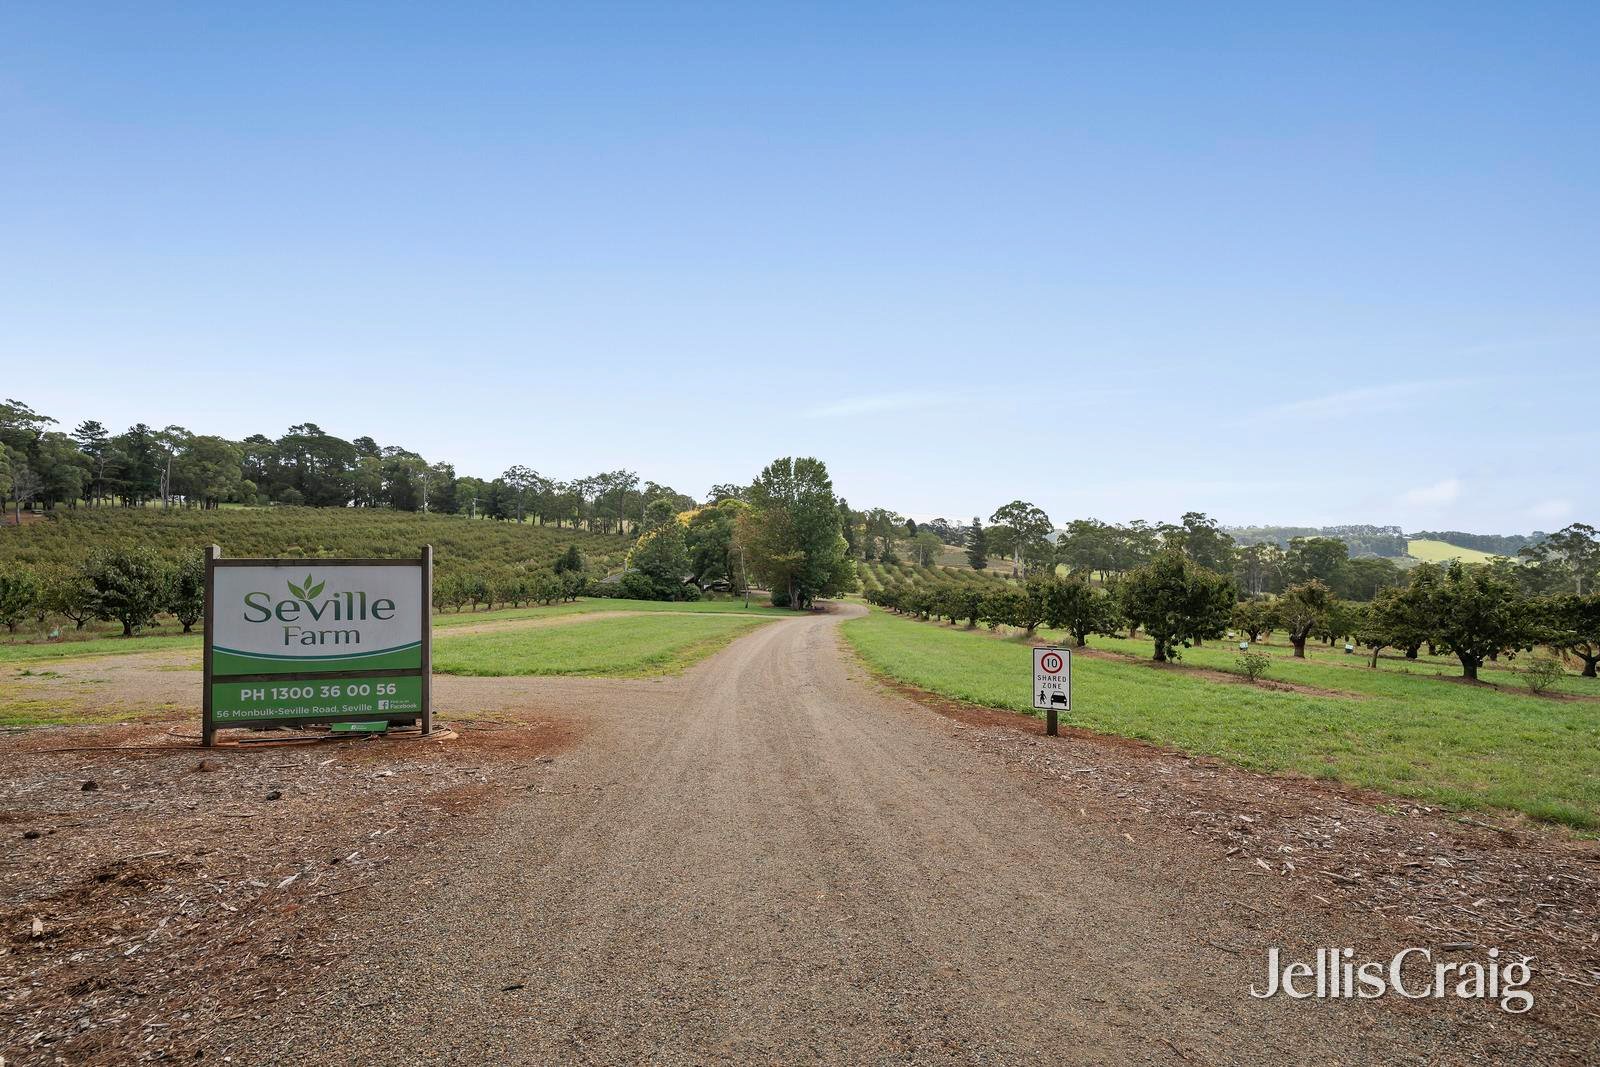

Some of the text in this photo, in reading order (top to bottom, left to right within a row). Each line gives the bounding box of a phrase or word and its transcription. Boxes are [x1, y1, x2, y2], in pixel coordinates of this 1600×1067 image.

[243, 591, 396, 623] Seville
[282, 625, 360, 646] Farm
[1047, 658, 1058, 668] 10
[1037, 675, 1067, 683] SHARED
[240, 683, 397, 701] PH 1300 36 00 56
[216, 703, 372, 718] 56 Monbulk-Seville Road, Seville
